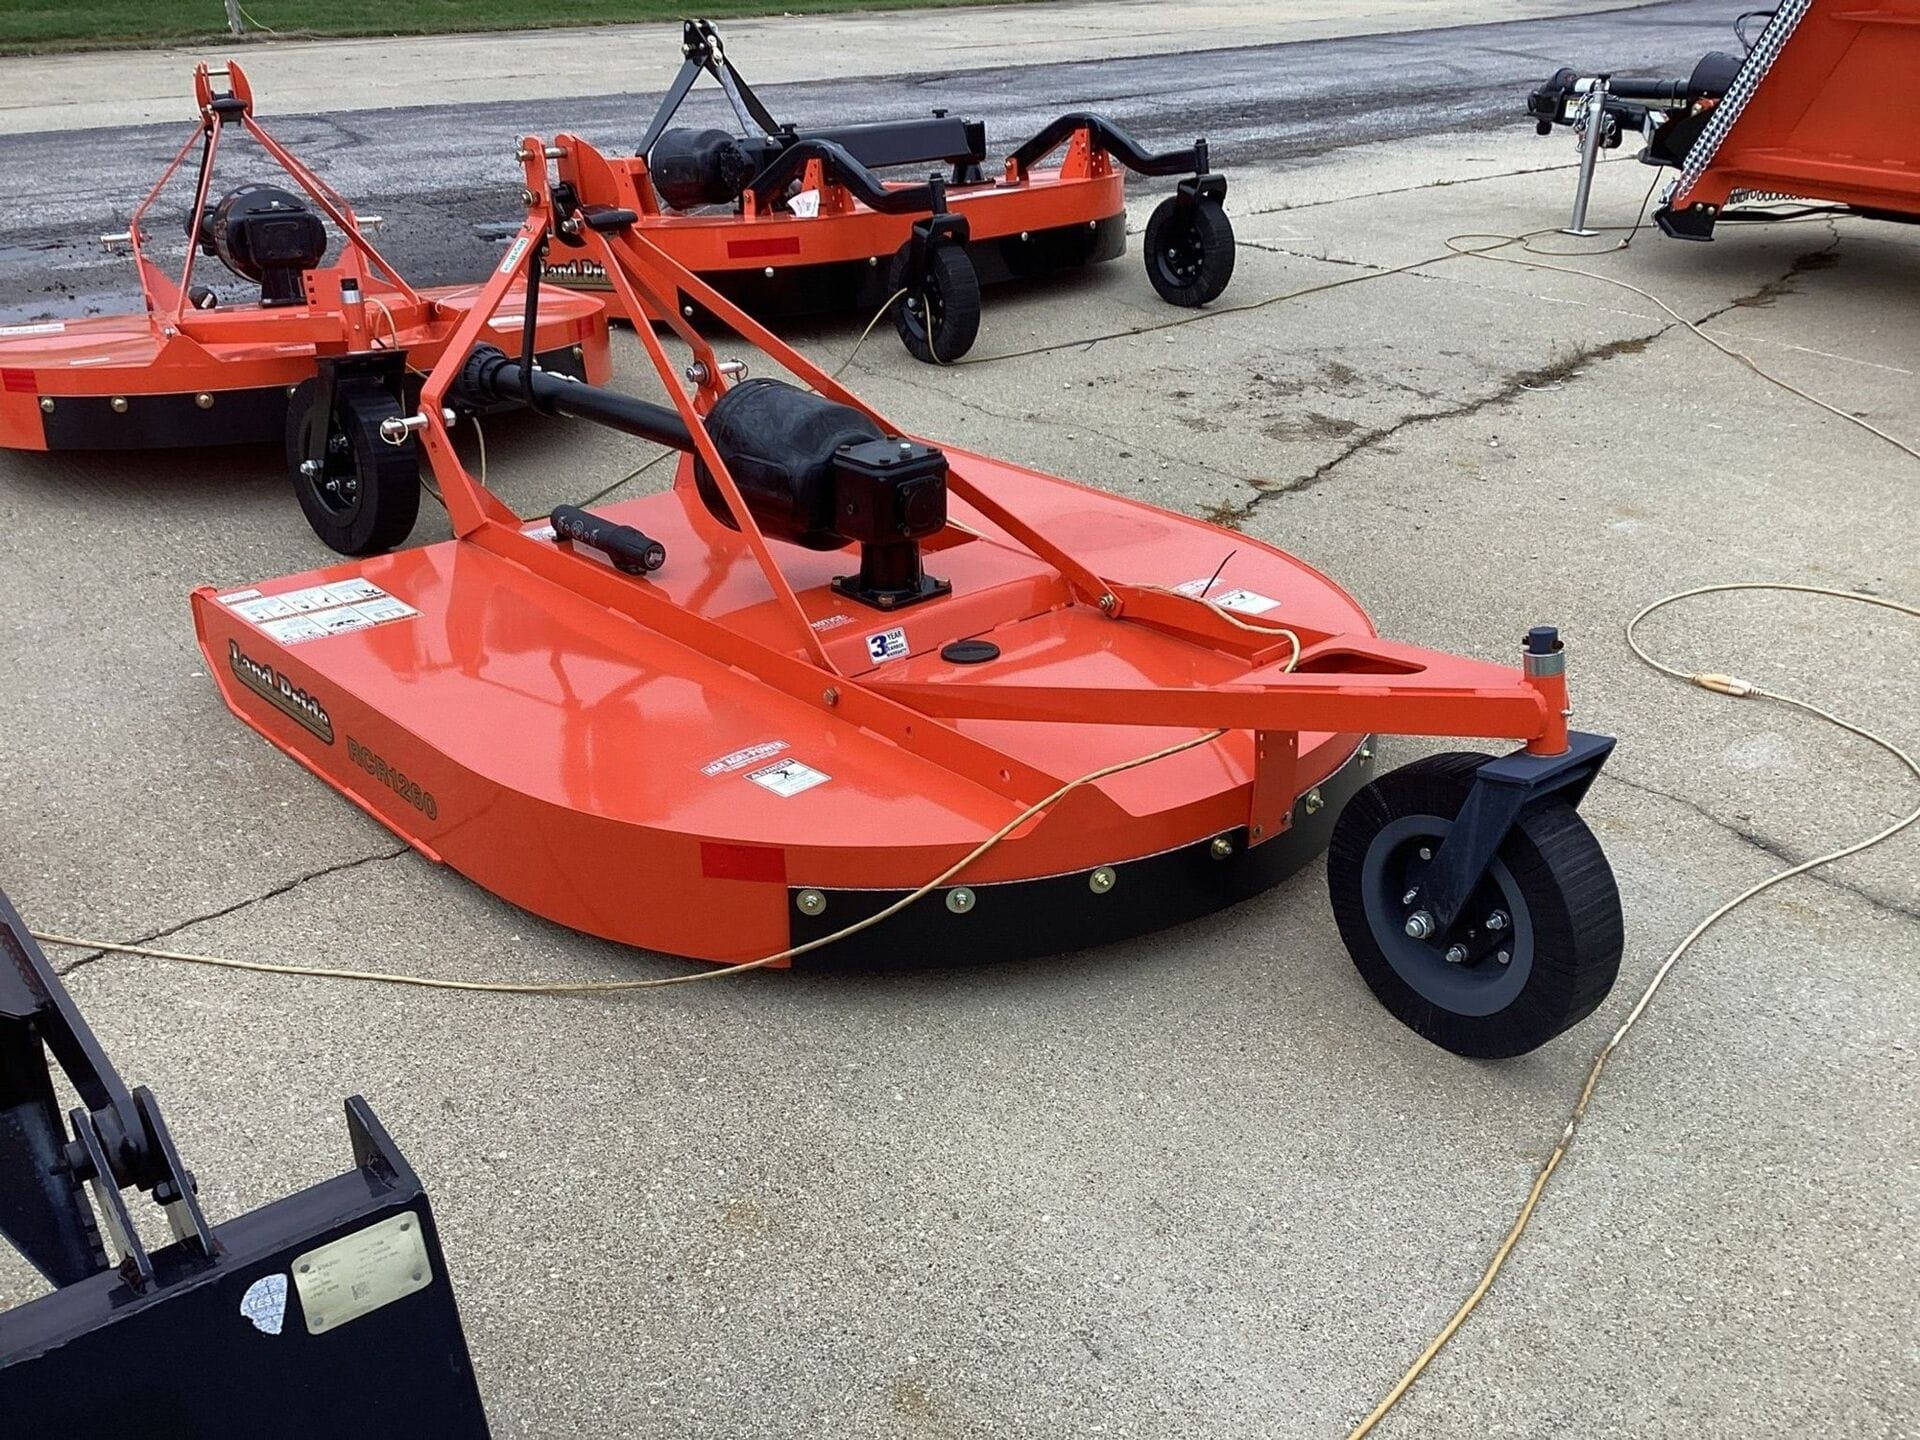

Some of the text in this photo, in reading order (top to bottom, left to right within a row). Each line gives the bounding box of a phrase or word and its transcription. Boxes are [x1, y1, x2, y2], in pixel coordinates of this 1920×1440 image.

[870, 631, 902, 657] 3 YEAR
[229, 639, 274, 688] Land
